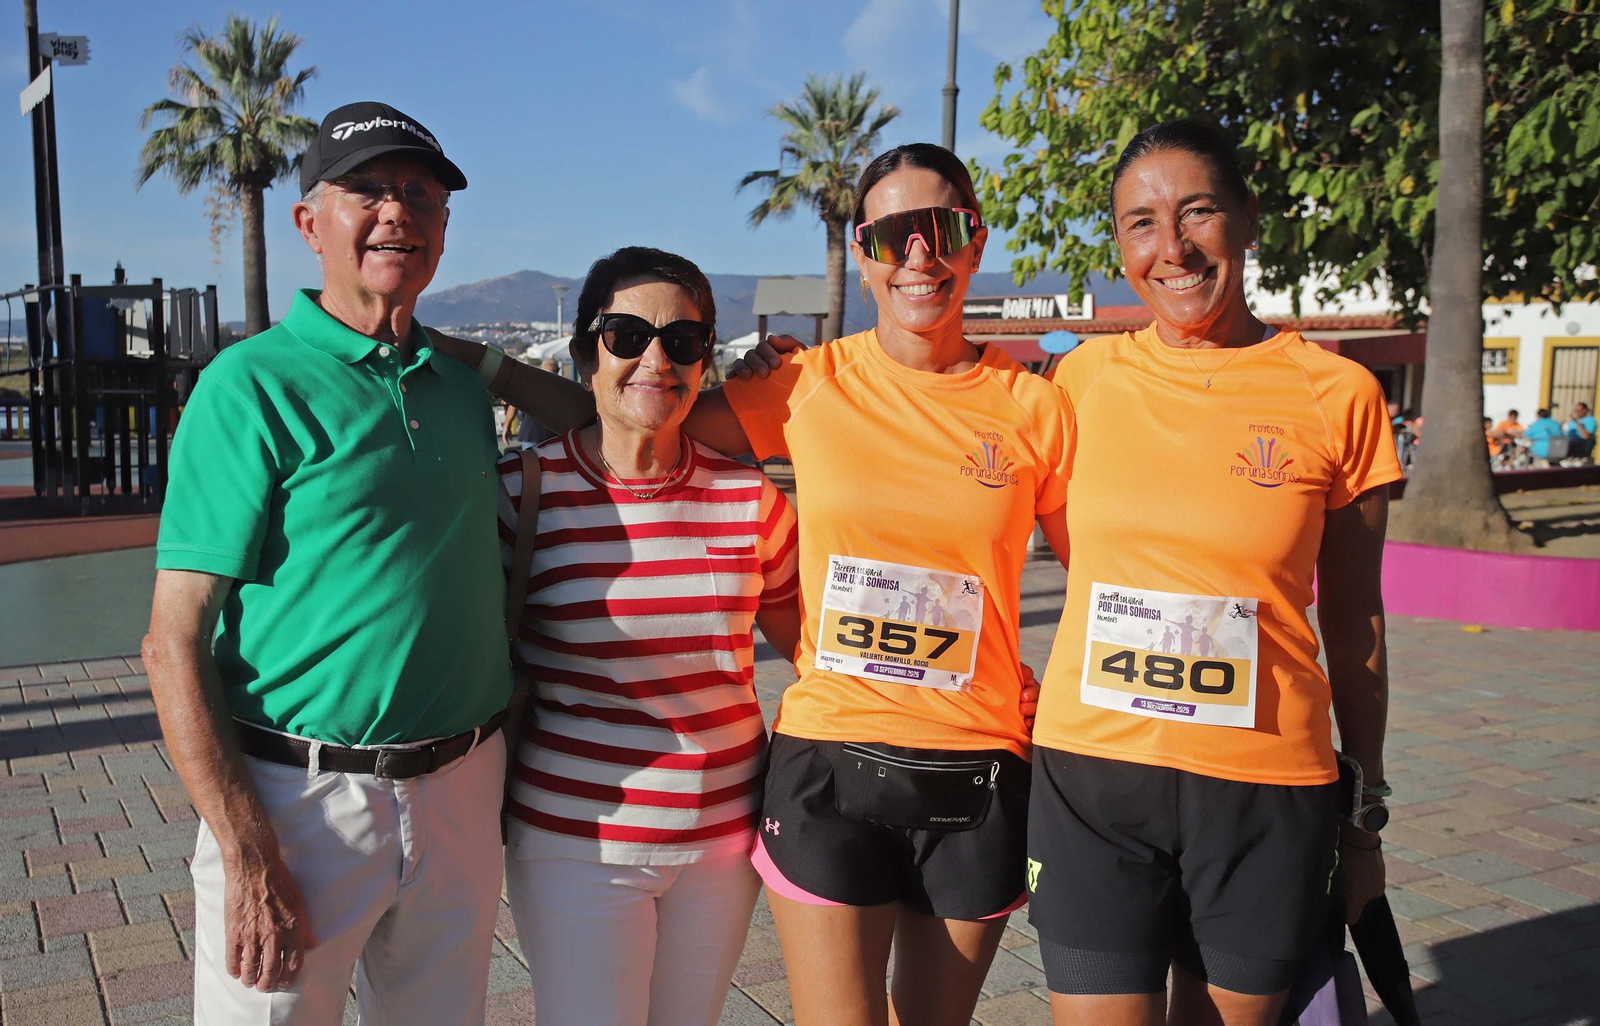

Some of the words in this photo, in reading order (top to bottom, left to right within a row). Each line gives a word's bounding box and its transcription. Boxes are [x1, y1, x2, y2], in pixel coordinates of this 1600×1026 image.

[51, 38, 77, 49] vinci
[53, 48, 79, 59] play
[833, 571, 848, 584] POR
[866, 576, 900, 591] SONRISA
[1097, 600, 1112, 613] POR
[1113, 603, 1128, 616] UNA
[1129, 606, 1162, 621] SONRISA
[836, 615, 960, 660] 357
[860, 651, 884, 661] VALIENTE
[913, 659, 929, 668] ROCIO
[879, 665, 907, 677] SEPTIEMBRE
[1101, 649, 1235, 695] 480
